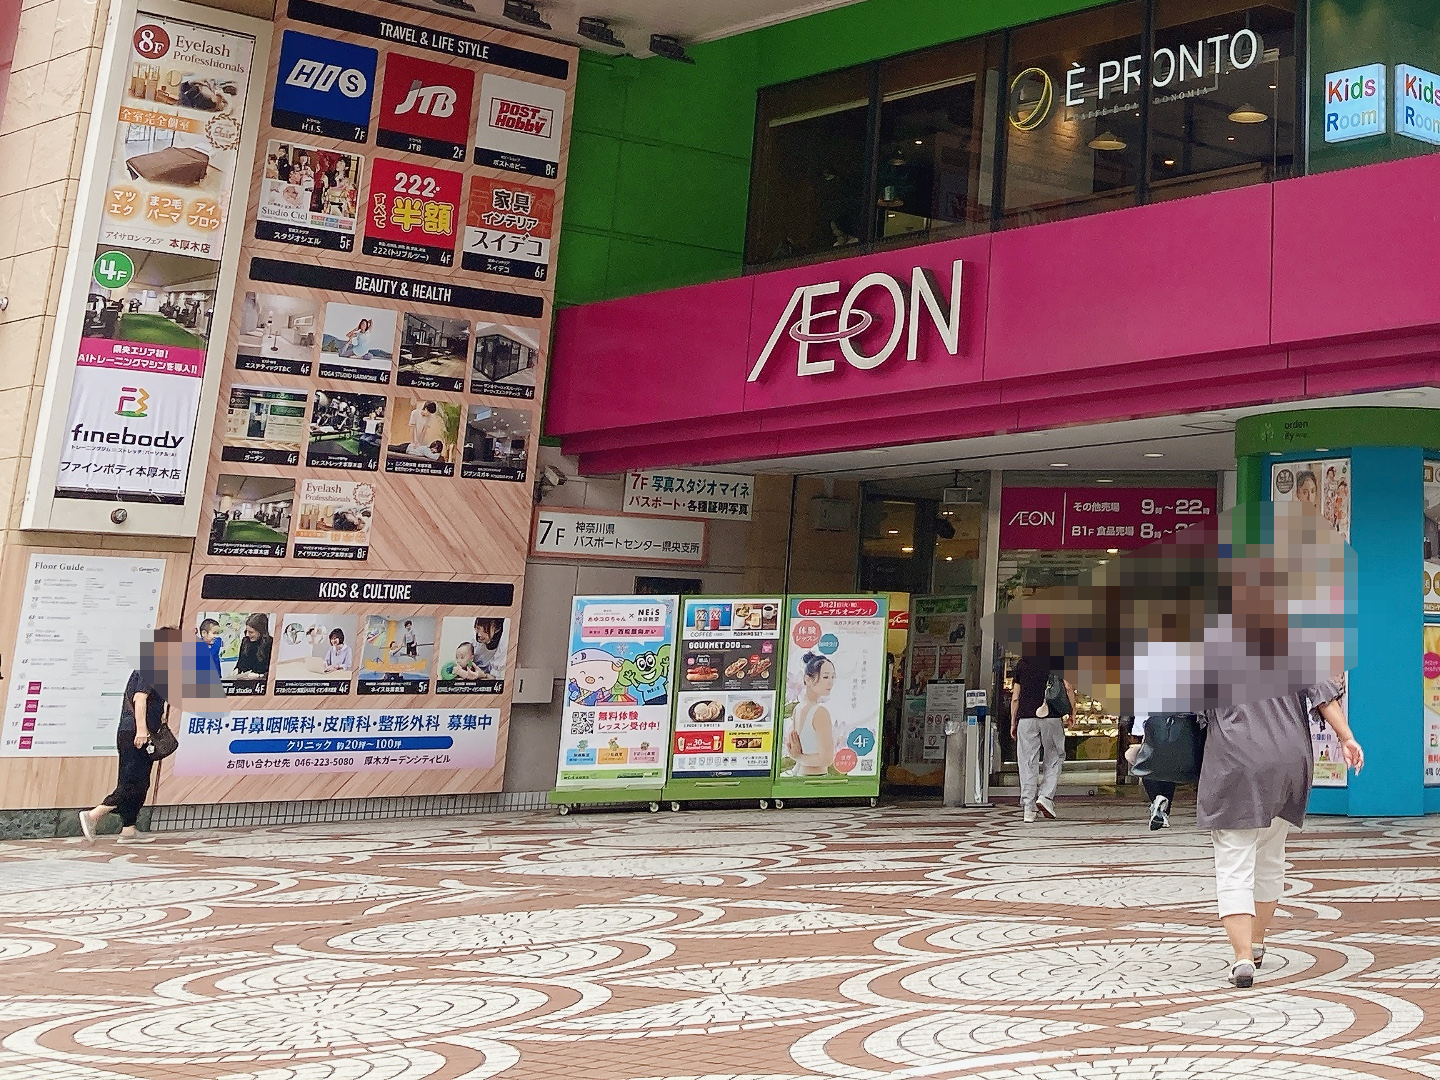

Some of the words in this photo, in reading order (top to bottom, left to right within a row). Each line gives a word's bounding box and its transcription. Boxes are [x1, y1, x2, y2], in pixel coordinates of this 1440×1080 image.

[138, 29, 164, 54] 8F
[175, 35, 230, 57] Eyelash
[380, 22, 418, 43] TRAVEL
[420, 31, 428, 45] &
[431, 33, 454, 52] LIFE
[458, 41, 489, 60] STYLE
[1099, 28, 1257, 100] PRONTO
[394, 79, 458, 118] JTB
[1328, 75, 1376, 104] Kids
[121, 108, 190, 131] 全室完全個室
[1327, 110, 1377, 132] Room
[354, 127, 365, 141] 7F
[408, 142, 422, 152] JTB
[453, 146, 464, 159] 2F
[393, 172, 436, 198] 222
[149, 195, 182, 209] まつ毛
[492, 188, 531, 214] 家具
[391, 197, 453, 235] 半額
[482, 212, 538, 232] インテリア
[169, 238, 210, 254] 本厚木店
[340, 236, 351, 250] 5F
[471, 229, 543, 257] スイデコ
[440, 252, 451, 265] 4F
[100, 259, 127, 280] 4F
[534, 266, 545, 279] 6F
[355, 275, 398, 295] BEAUTY
[400, 282, 408, 296] &
[412, 283, 452, 302] HEALTH
[71, 423, 185, 449] finebody
[61, 461, 182, 480] ファインボディ本厚木店
[306, 482, 342, 494] Eyelash
[632, 473, 648, 490] 7F
[652, 475, 750, 499] 写真スタジオマイネ
[629, 496, 748, 516] パスポート・各種証明写真
[1073, 502, 1120, 512] その他売場
[538, 519, 566, 546] 7F
[575, 521, 615, 535] 神奈川県
[574, 536, 700, 554] パスポートセンター県央支所
[319, 582, 347, 598] KIDS
[349, 583, 359, 598] &
[363, 583, 411, 599] CULTURE
[447, 714, 492, 731] 募集中
[598, 711, 639, 721] 無料体験
[287, 740, 331, 751] クリニック
[853, 734, 869, 748] 4F
[227, 759, 290, 769] お問い合わせ先
[364, 755, 450, 766] 厚木ガーデンシティビル
